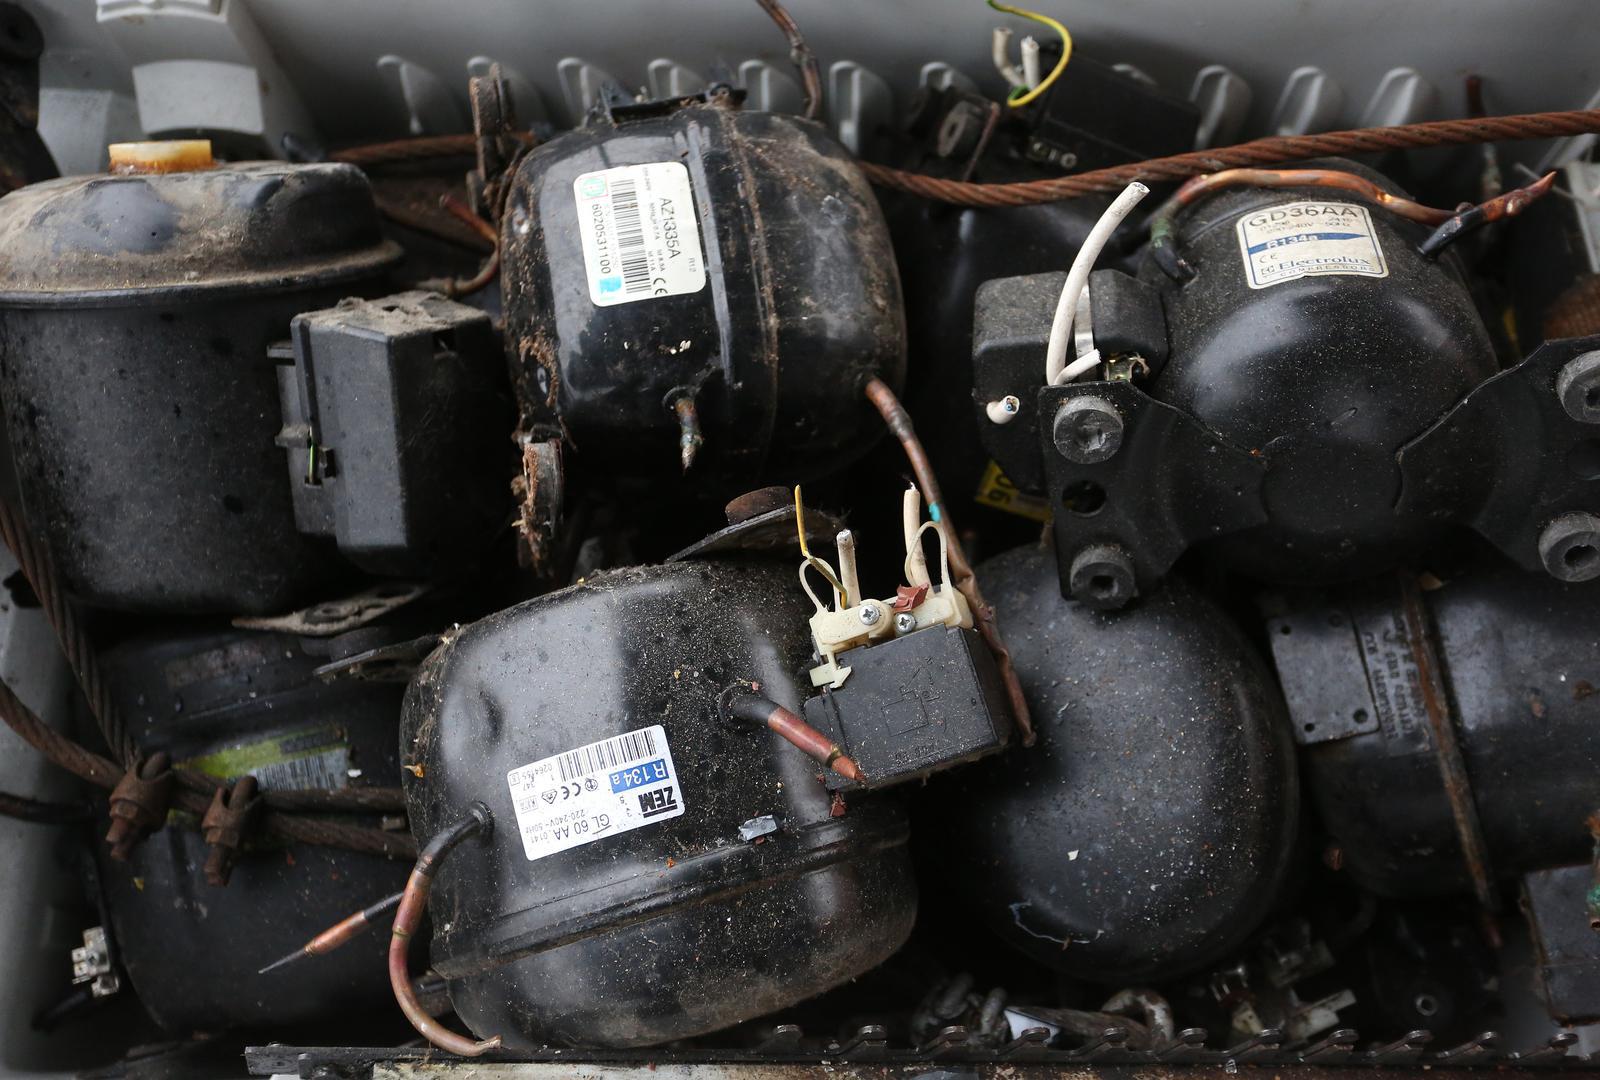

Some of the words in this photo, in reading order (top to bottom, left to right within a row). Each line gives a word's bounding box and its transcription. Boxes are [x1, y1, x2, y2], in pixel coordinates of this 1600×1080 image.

[1249, 205, 1358, 227] GD36AA
[659, 197, 681, 259] AZ1335A
[591, 203, 612, 274] 6020531100
[1267, 234, 1319, 249] R134a
[1279, 255, 1371, 270] Electrolux
[637, 786, 676, 811] ZEM
[573, 819, 589, 835] 60
[591, 813, 610, 828] GL
[553, 826, 570, 841] AA
